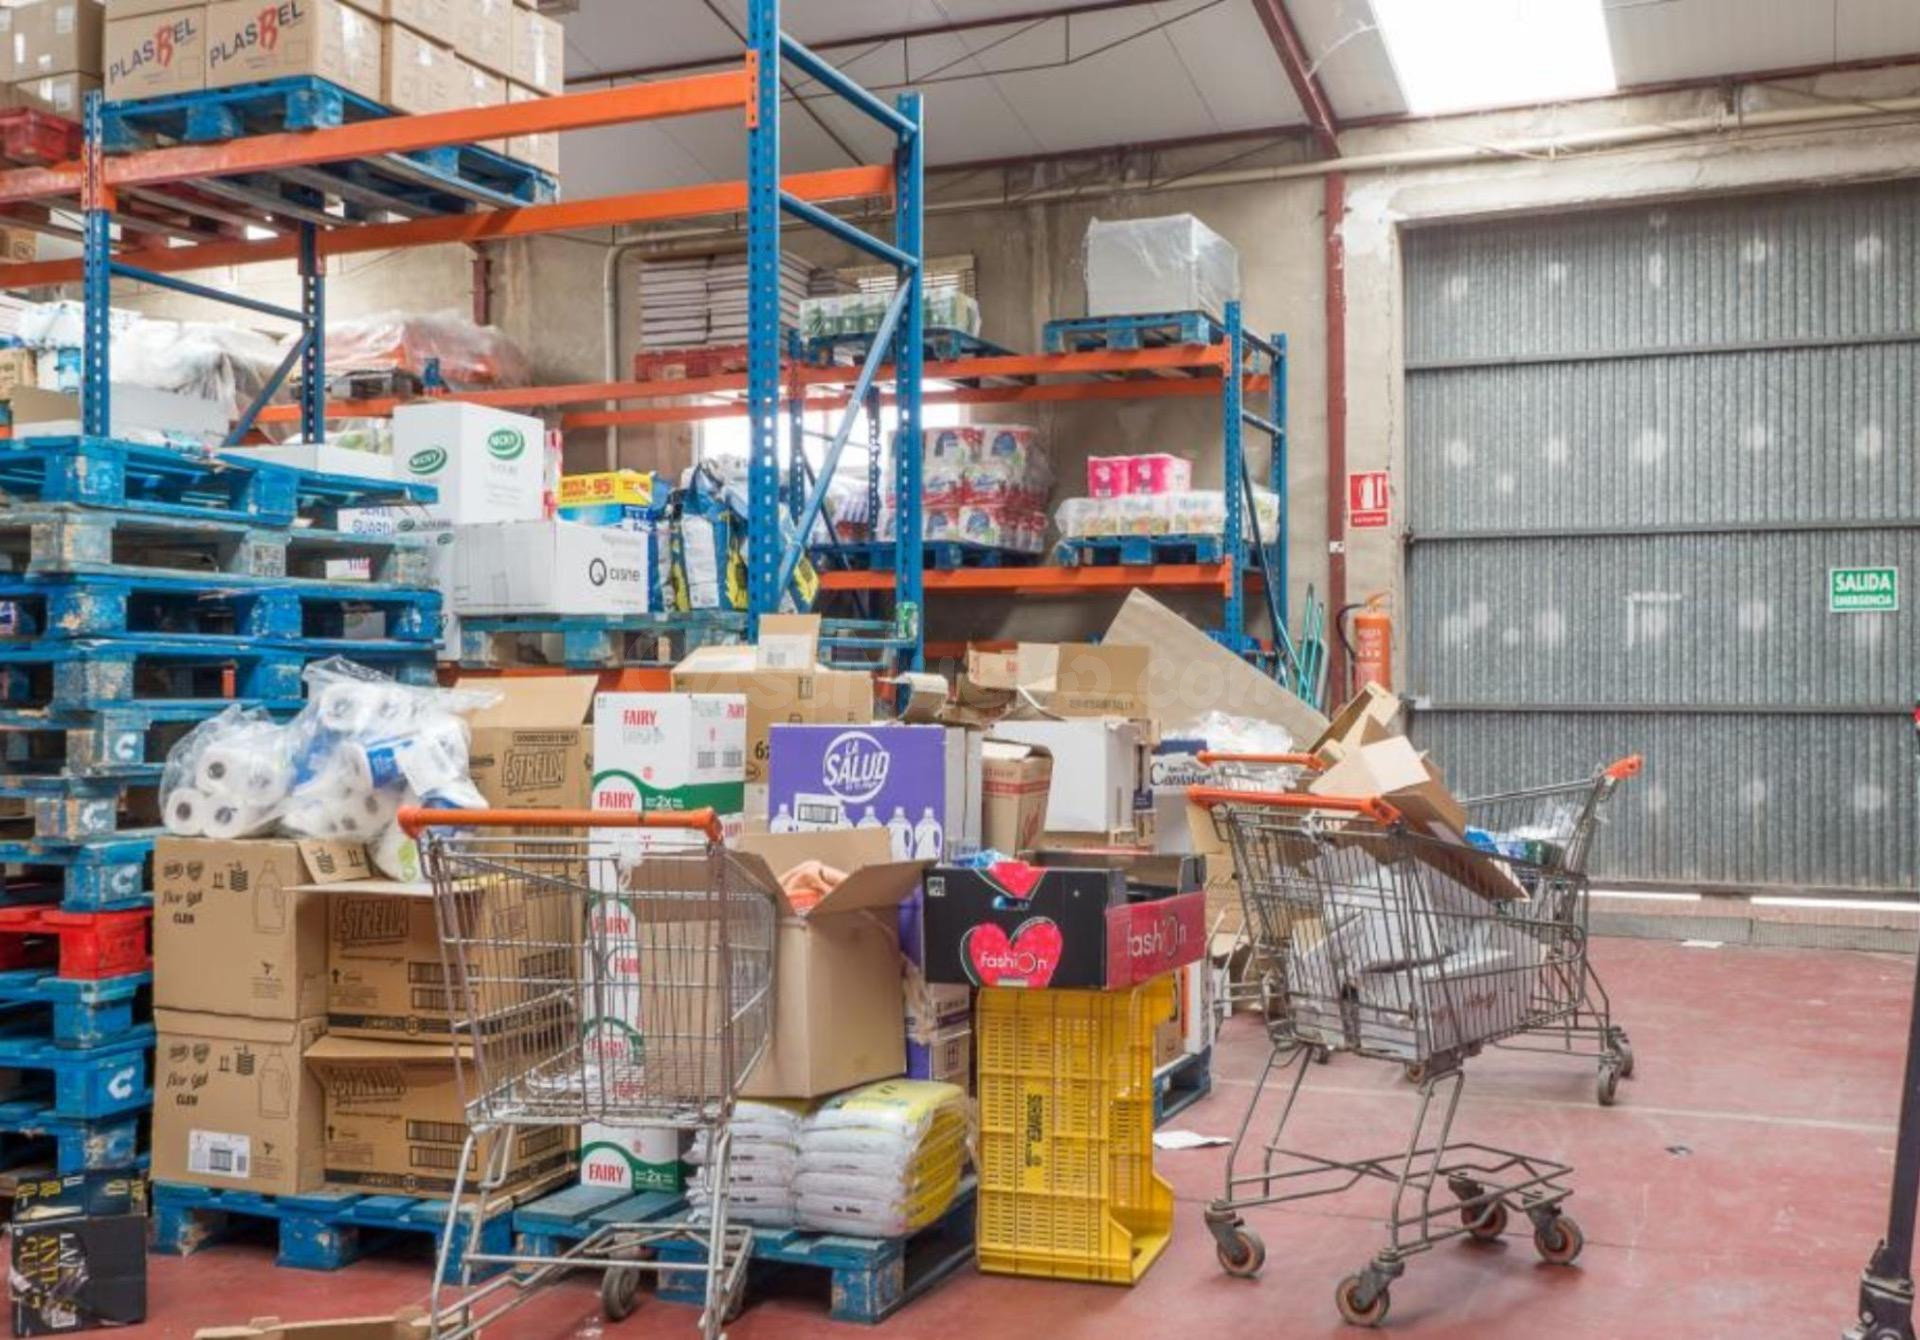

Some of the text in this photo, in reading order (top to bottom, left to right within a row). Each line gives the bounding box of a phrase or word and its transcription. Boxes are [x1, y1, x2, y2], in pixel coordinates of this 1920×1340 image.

[1835, 572, 1892, 592] SALIDA
[623, 709, 657, 726] FAIRY
[822, 751, 891, 787] SALUD
[599, 791, 635, 809] FAIRY
[588, 1164, 625, 1183] FAIRY
